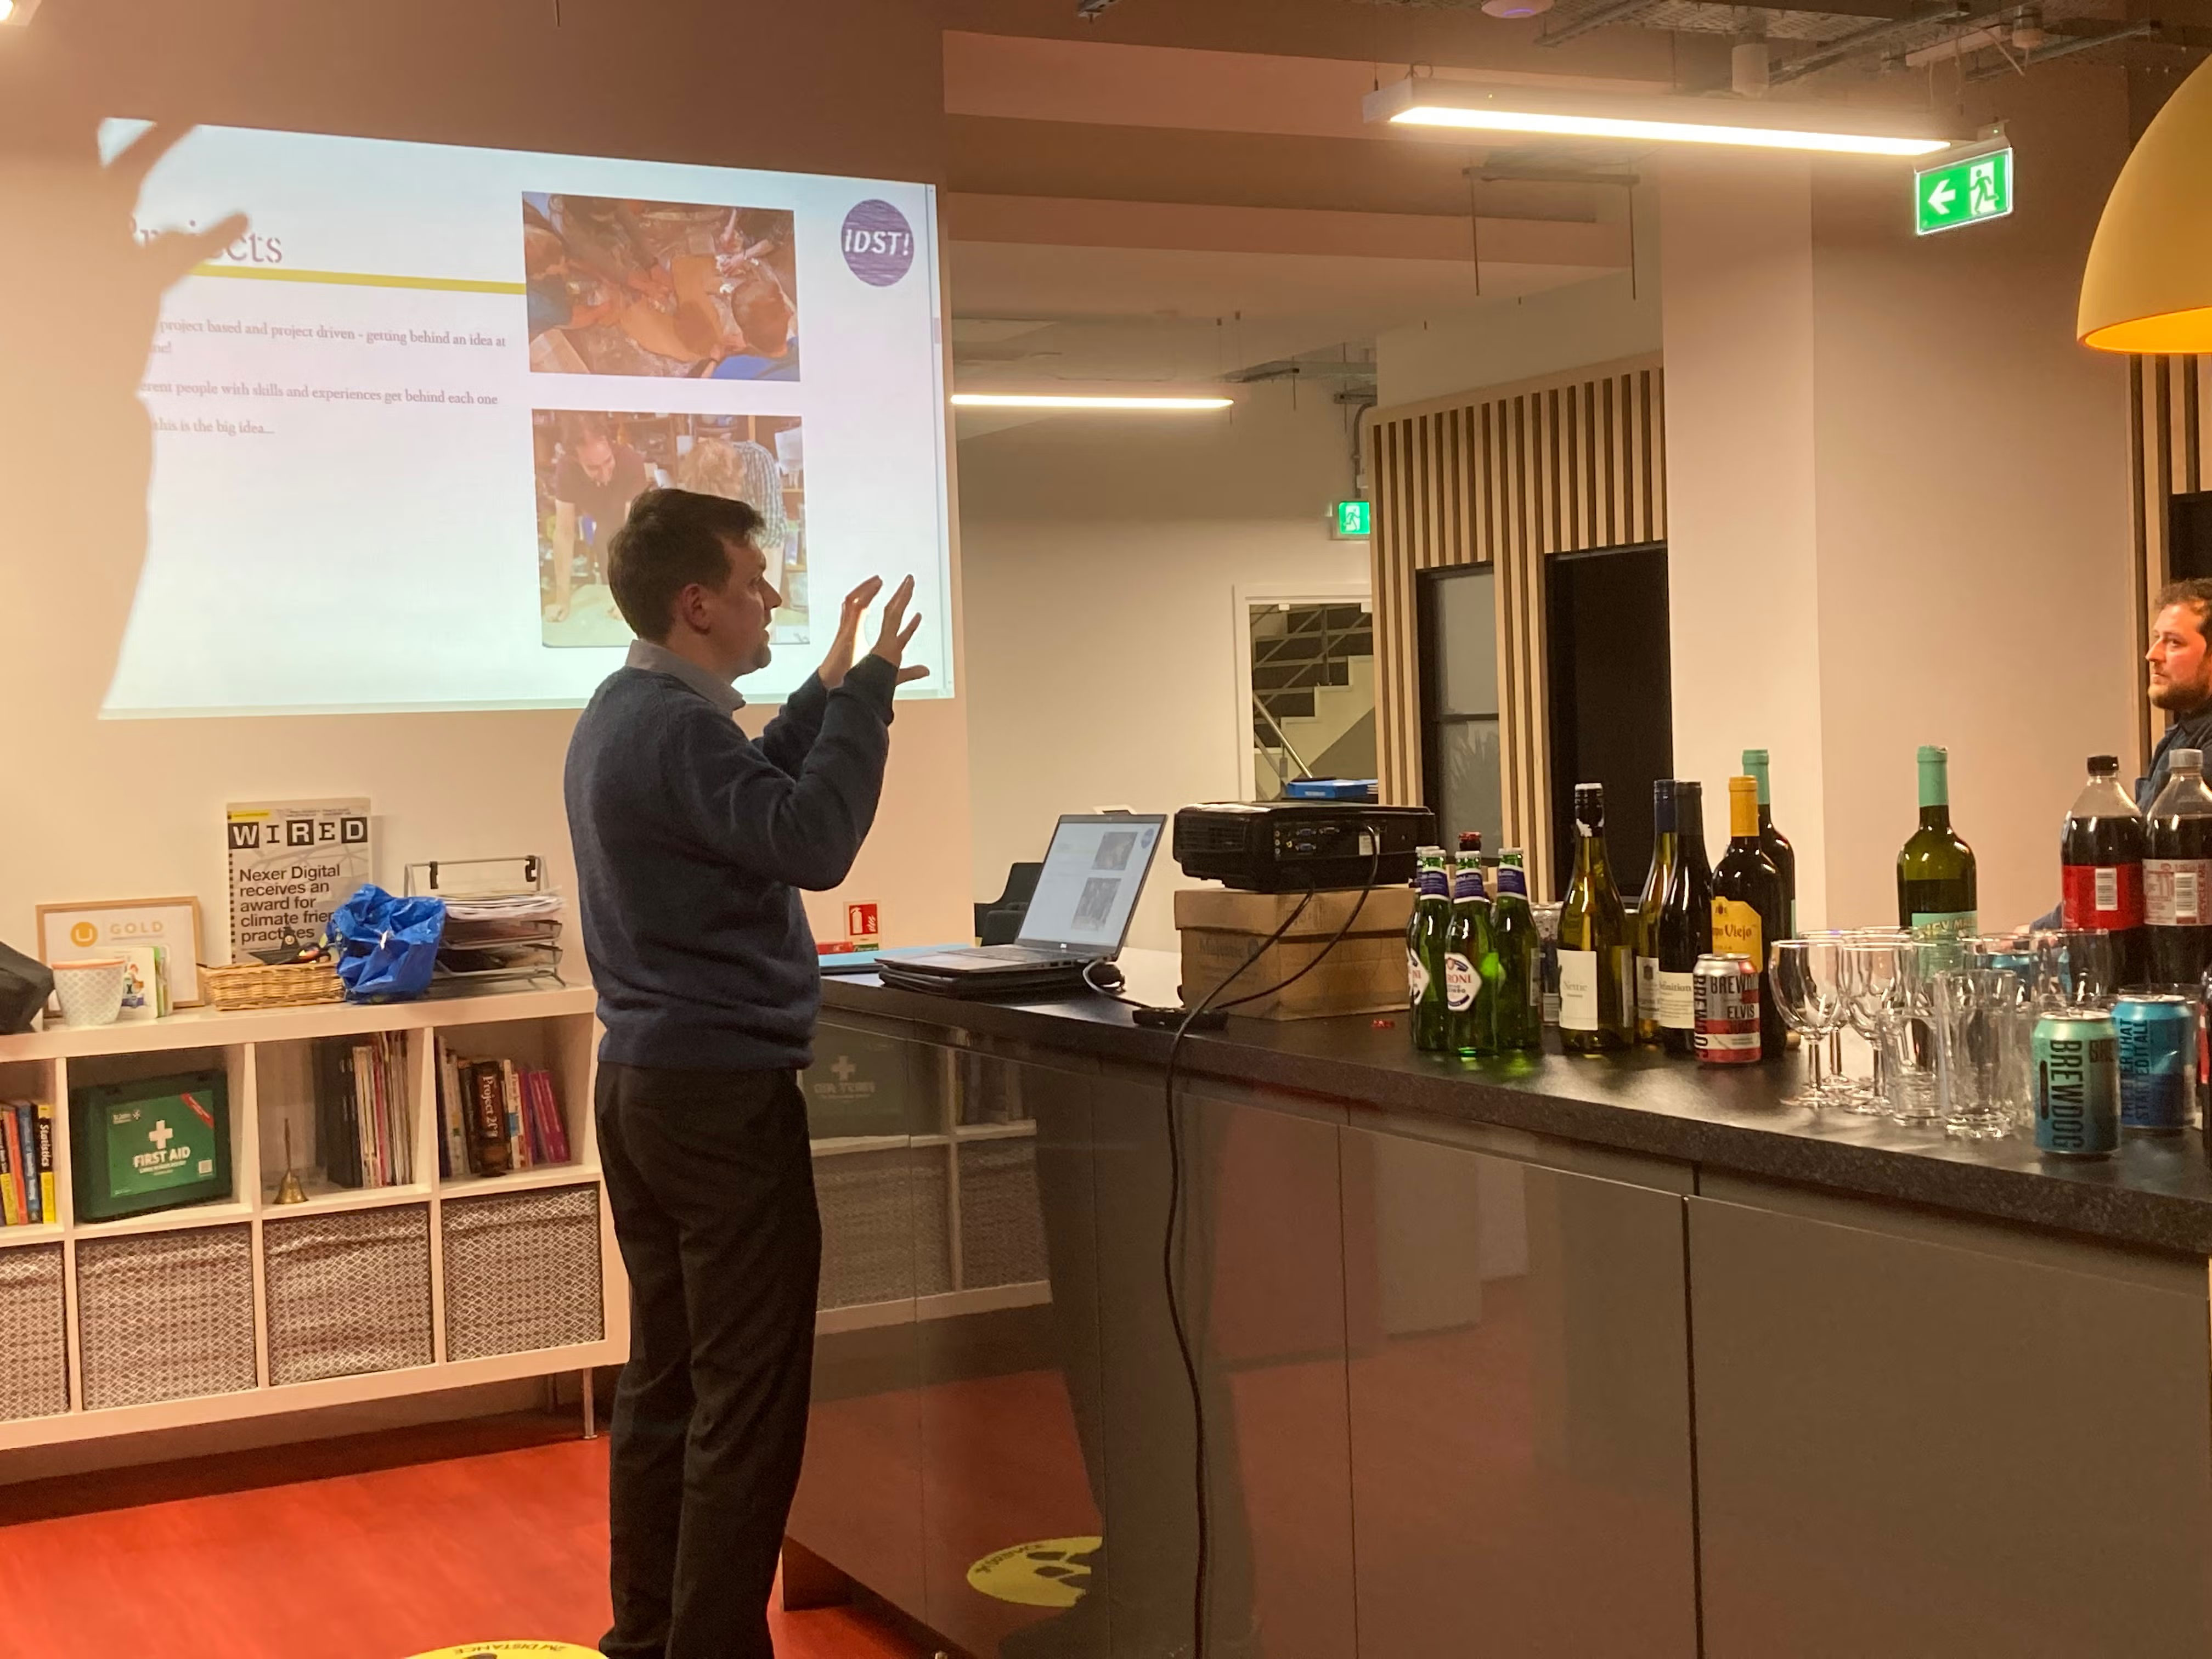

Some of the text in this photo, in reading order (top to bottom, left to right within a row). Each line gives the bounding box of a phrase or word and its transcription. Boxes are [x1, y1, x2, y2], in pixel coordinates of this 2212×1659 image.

[845, 229, 909, 256] IDST!
[160, 318, 203, 335] project
[207, 318, 241, 334] based
[245, 321, 267, 335] and
[272, 324, 313, 339] project
[317, 325, 355, 339] driven
[366, 330, 407, 345] getting
[409, 329, 449, 344] behind
[453, 335, 466, 345] an
[470, 332, 493, 346] idea
[496, 337, 506, 347] at
[176, 381, 218, 399] people
[221, 382, 249, 396] with
[252, 383, 283, 397] skills
[286, 384, 309, 398] and
[312, 387, 381, 402] experiences
[385, 391, 402, 404] get
[405, 388, 445, 403] behind
[448, 391, 474, 404] each
[477, 395, 498, 404] one
[180, 420, 190, 432] is
[194, 419, 213, 432] the
[216, 419, 236, 436] big
[230, 819, 366, 848] WIRED
[240, 864, 340, 882] Nexer Digital
[240, 882, 329, 897] receives an
[240, 896, 317, 912] award for
[110, 920, 164, 935] GOLD
[241, 912, 298, 927] climate
[1728, 1005, 1754, 1019] ELVIS
[2120, 1018, 2132, 1052] THAT
[2133, 1020, 2148, 1043] ALL
[482, 1075, 494, 1115] Project
[40, 1124, 53, 1167] Statistics
[134, 1150, 167, 1168] FIRST
[170, 1146, 190, 1161] AID
